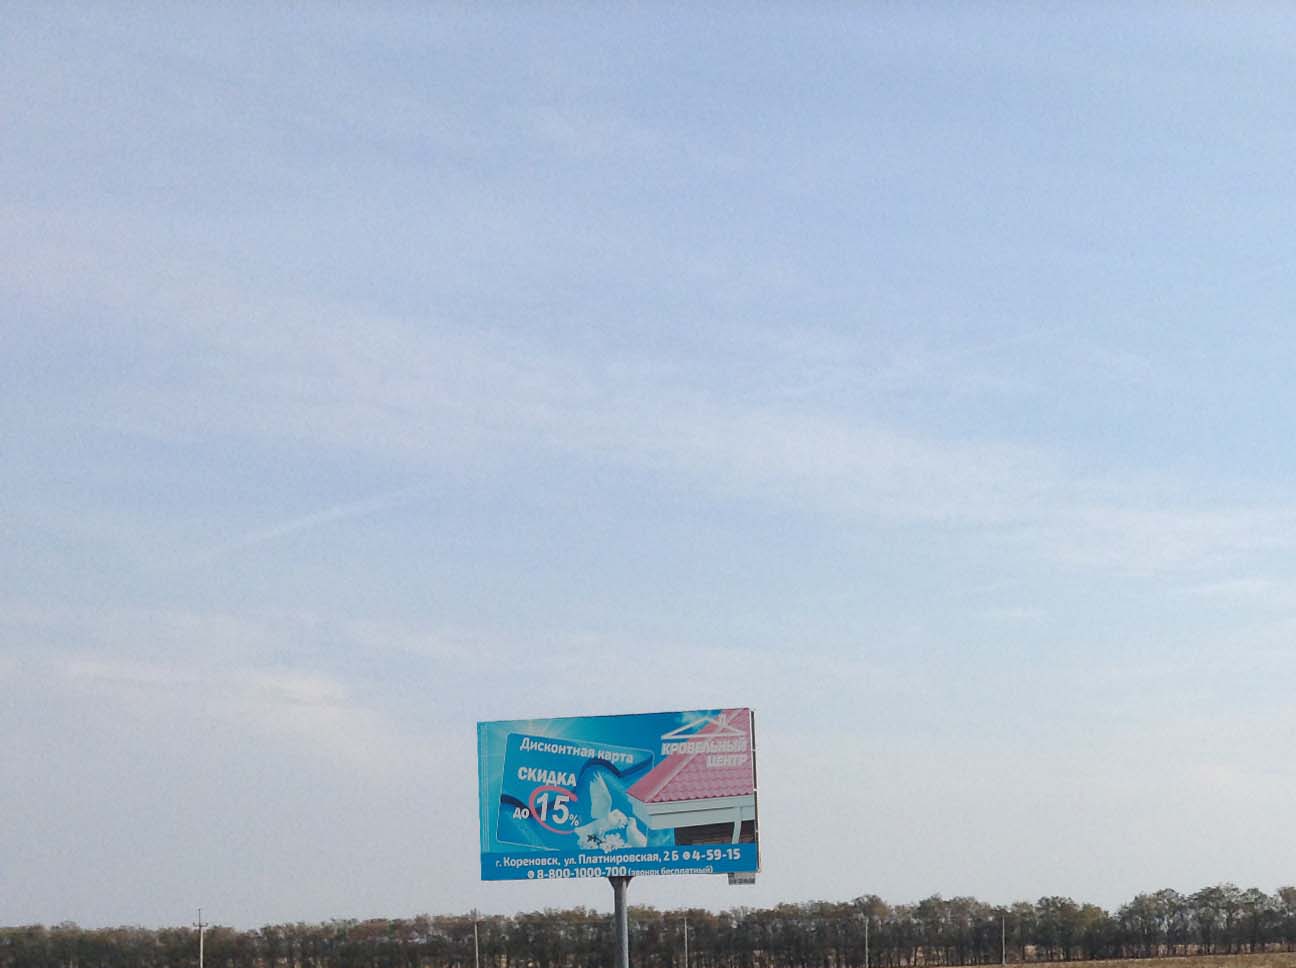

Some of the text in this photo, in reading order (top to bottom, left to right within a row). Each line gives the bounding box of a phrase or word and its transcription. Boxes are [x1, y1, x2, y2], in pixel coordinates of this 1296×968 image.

[520, 737, 634, 764] Дисконтная карта
[661, 737, 747, 756] КРОВЕЛЬНЫЙ
[706, 754, 747, 768] ЦЕНТР
[517, 766, 577, 787] СКИДКА
[503, 856, 560, 868] Кореновск,
[563, 858, 577, 867] ул.
[578, 852, 662, 867] Платнировская,
[692, 848, 741, 861] 4-59-15
[537, 866, 627, 879] 8-800-1000-700
